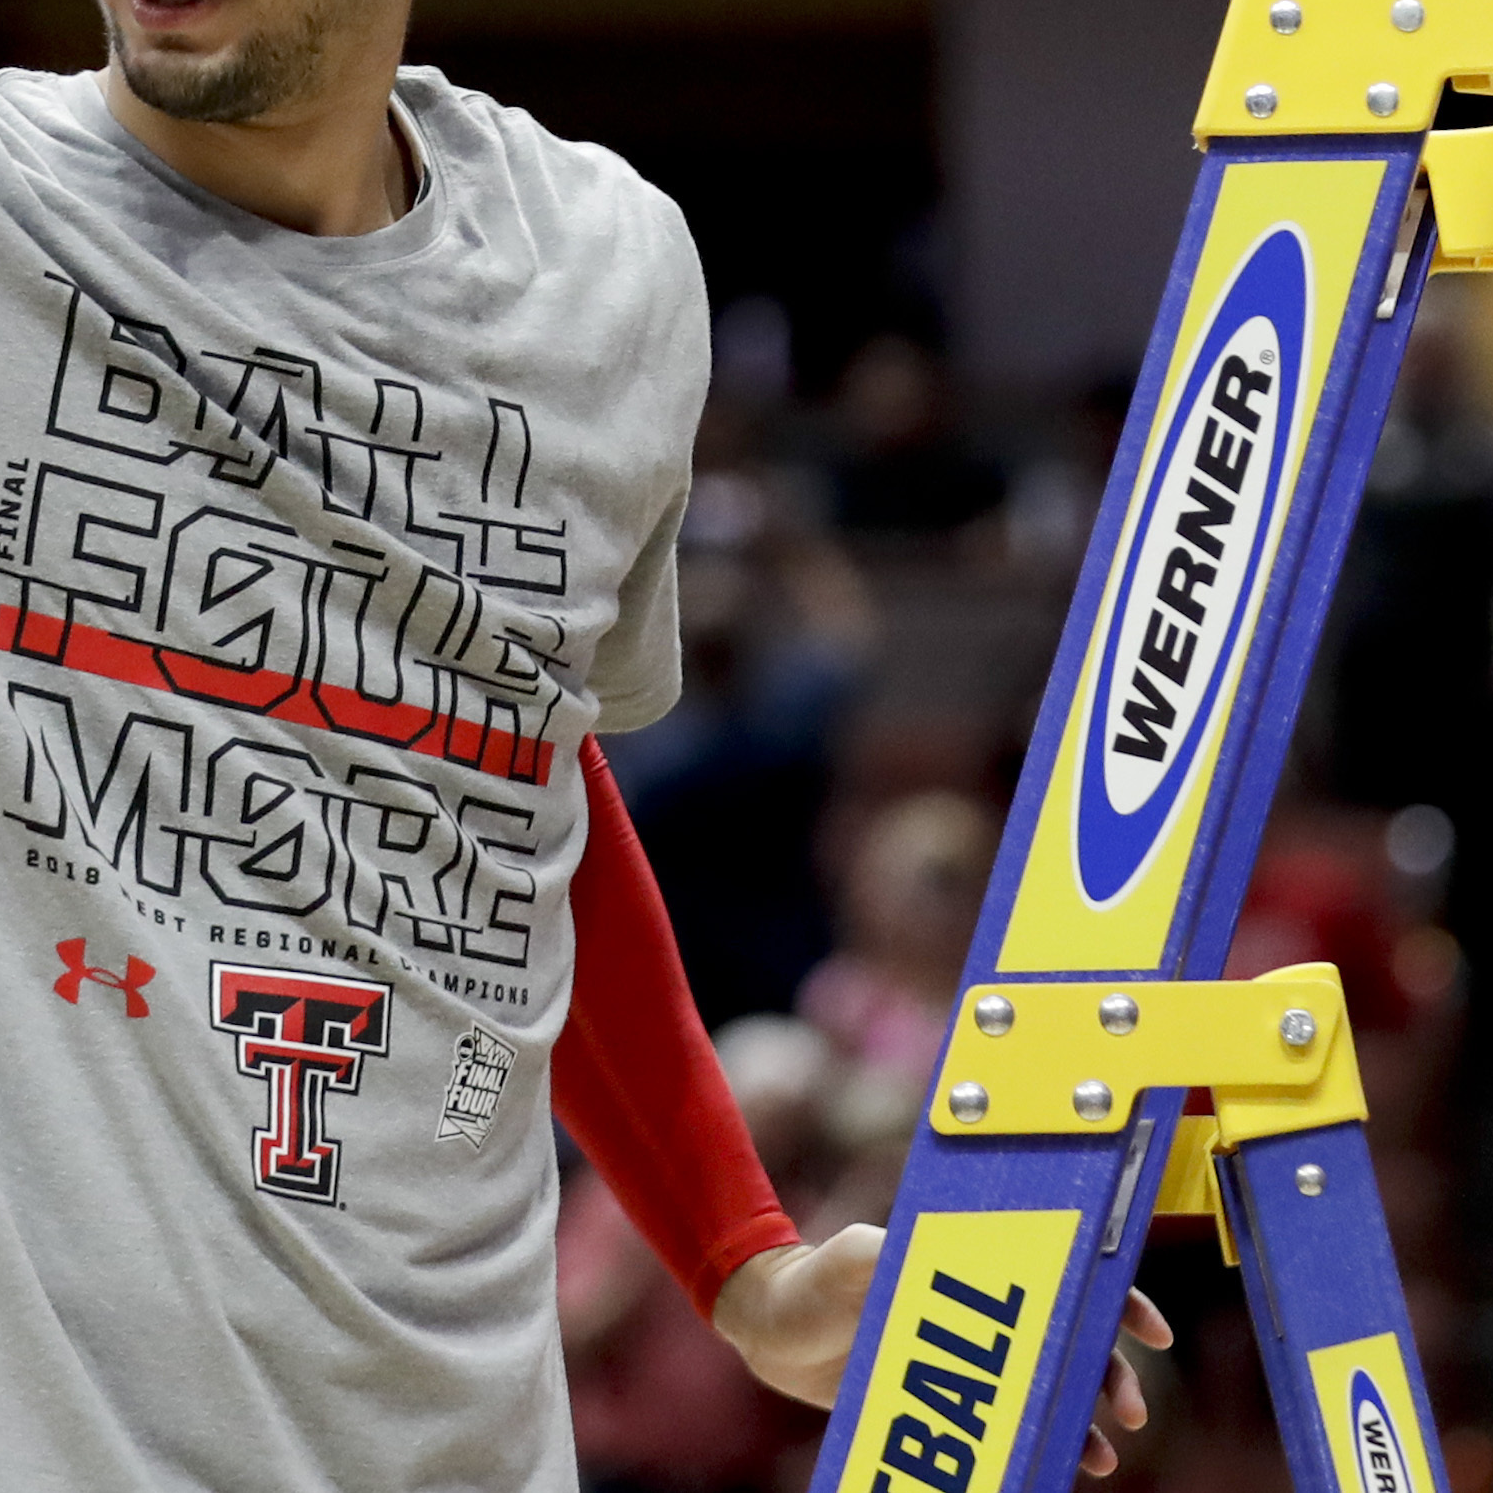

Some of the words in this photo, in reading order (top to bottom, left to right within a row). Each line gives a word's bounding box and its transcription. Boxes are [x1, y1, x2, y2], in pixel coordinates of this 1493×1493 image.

[1112, 353, 1272, 763] WERNER
[209, 925, 380, 965] REGIONAL
[453, 1061, 506, 1093] FINAL
[446, 1085, 499, 1119] FOUR
